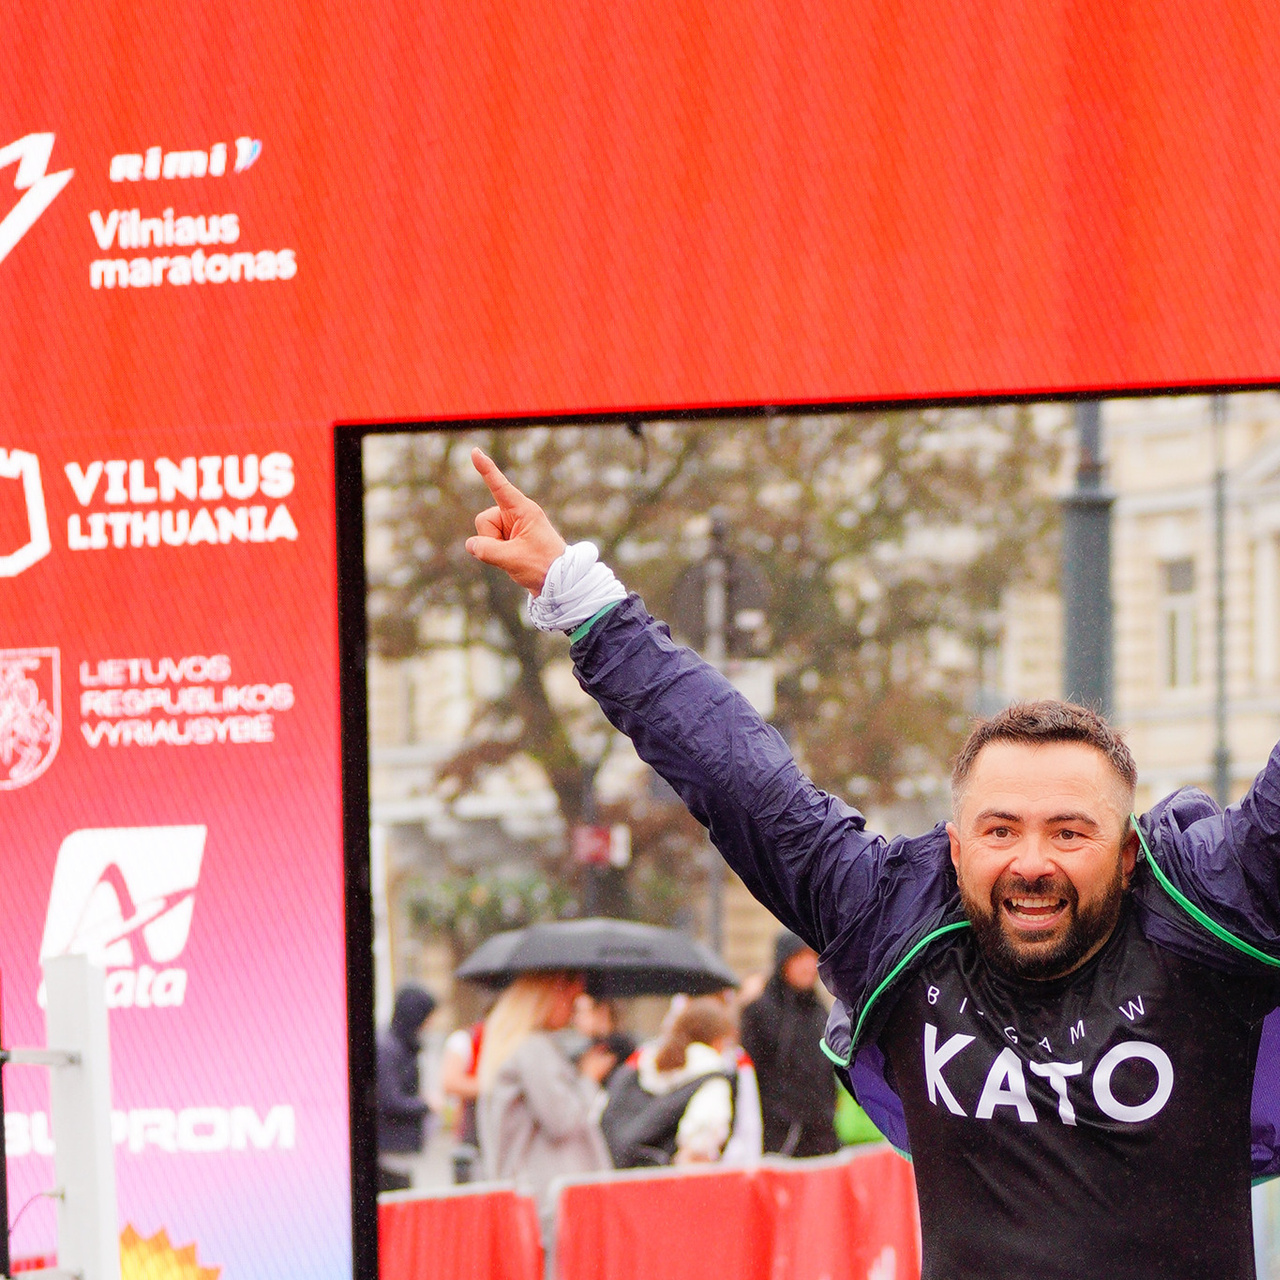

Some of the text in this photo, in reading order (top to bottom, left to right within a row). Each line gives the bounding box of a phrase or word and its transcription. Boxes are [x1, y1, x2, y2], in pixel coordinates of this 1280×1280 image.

[89, 208, 240, 250] Vilniaus
[90, 247, 297, 290] maratonas
[64, 451, 295, 507] VILNIUS
[67, 503, 298, 551] LITHUANIA
[79, 654, 232, 687] LIETUVOS
[80, 682, 296, 718] RESPUBLIKOS
[924, 1022, 1174, 1126] KATO
